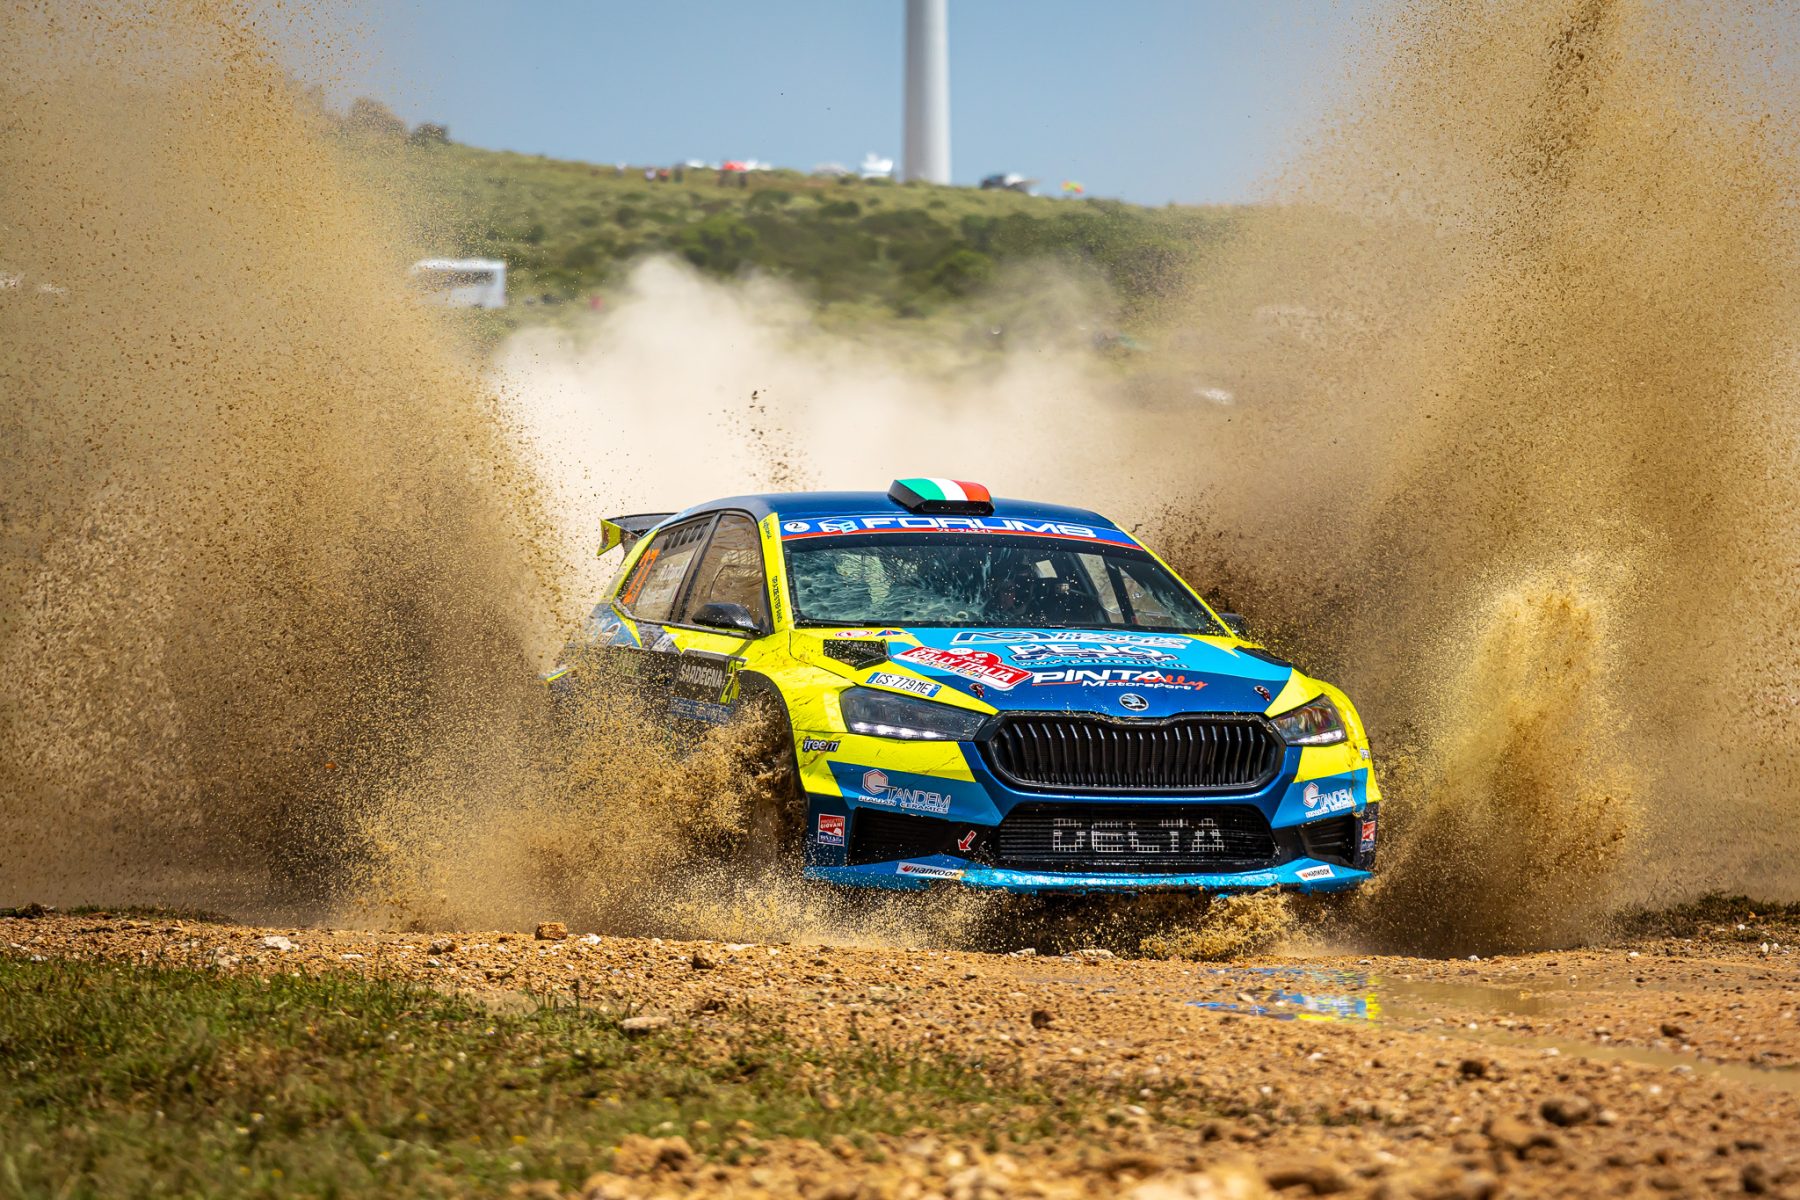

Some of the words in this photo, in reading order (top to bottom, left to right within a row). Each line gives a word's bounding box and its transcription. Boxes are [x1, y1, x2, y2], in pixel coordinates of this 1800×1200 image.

[861, 517, 1097, 538] FORUM8
[679, 663, 724, 689] SARDEGNA
[907, 650, 959, 665] RALLY
[959, 660, 1015, 682] ITALIA
[1032, 669, 1167, 683] PINTA
[1082, 680, 1192, 690] Motorsport
[858, 795, 897, 807] ITALIAN
[899, 801, 949, 814] CERAMICS
[885, 786, 951, 809] TANDEM
[1052, 818, 1225, 852] DELTA
